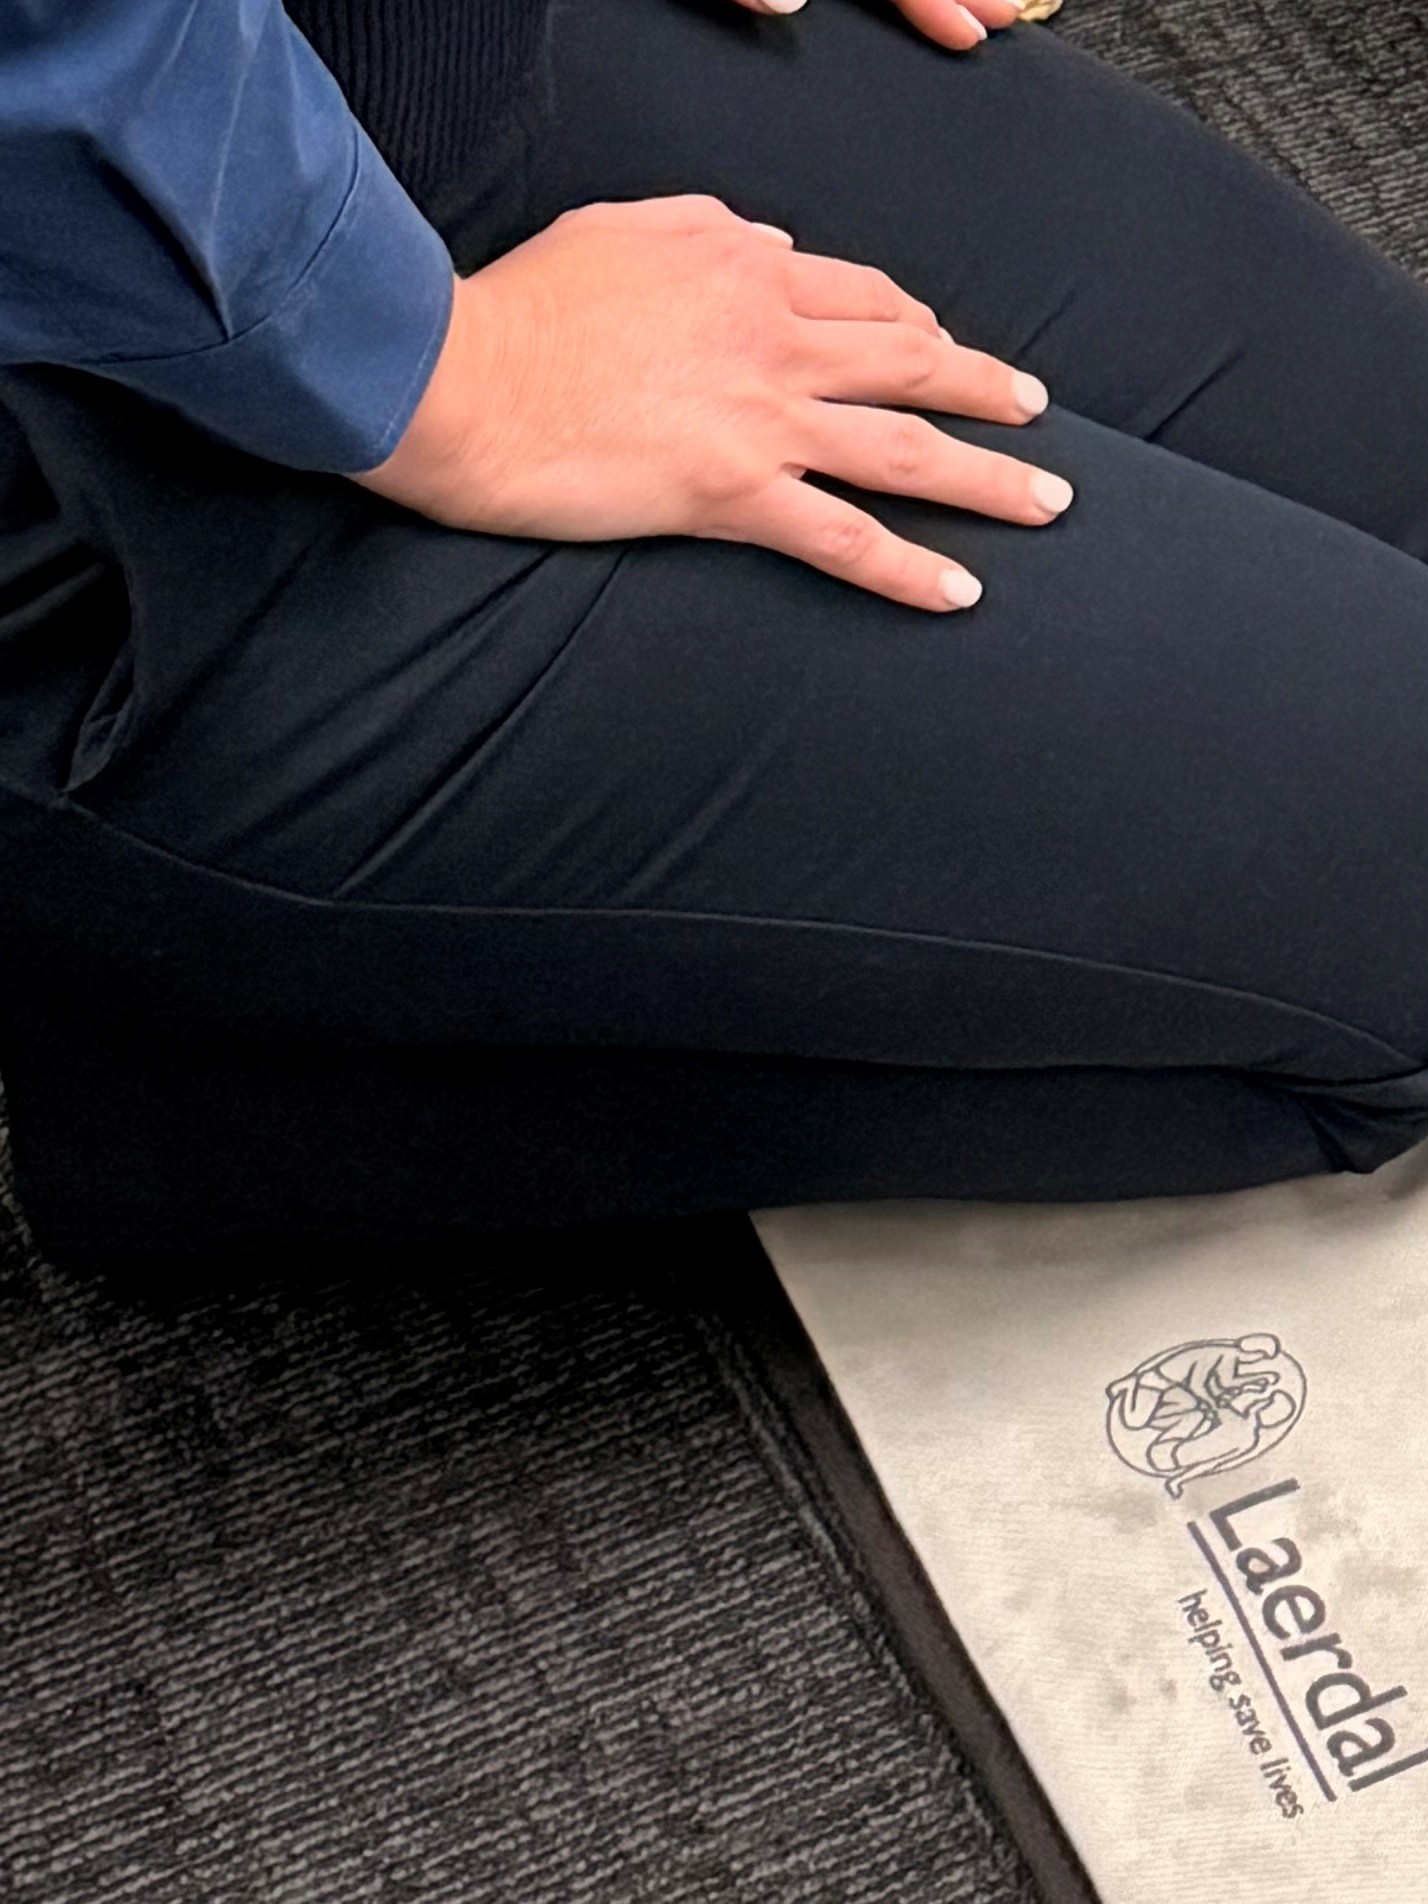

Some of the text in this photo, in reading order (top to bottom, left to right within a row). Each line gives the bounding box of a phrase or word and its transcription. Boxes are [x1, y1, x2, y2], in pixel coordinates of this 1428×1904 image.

[1176, 1589, 1304, 1819] helping save lives
